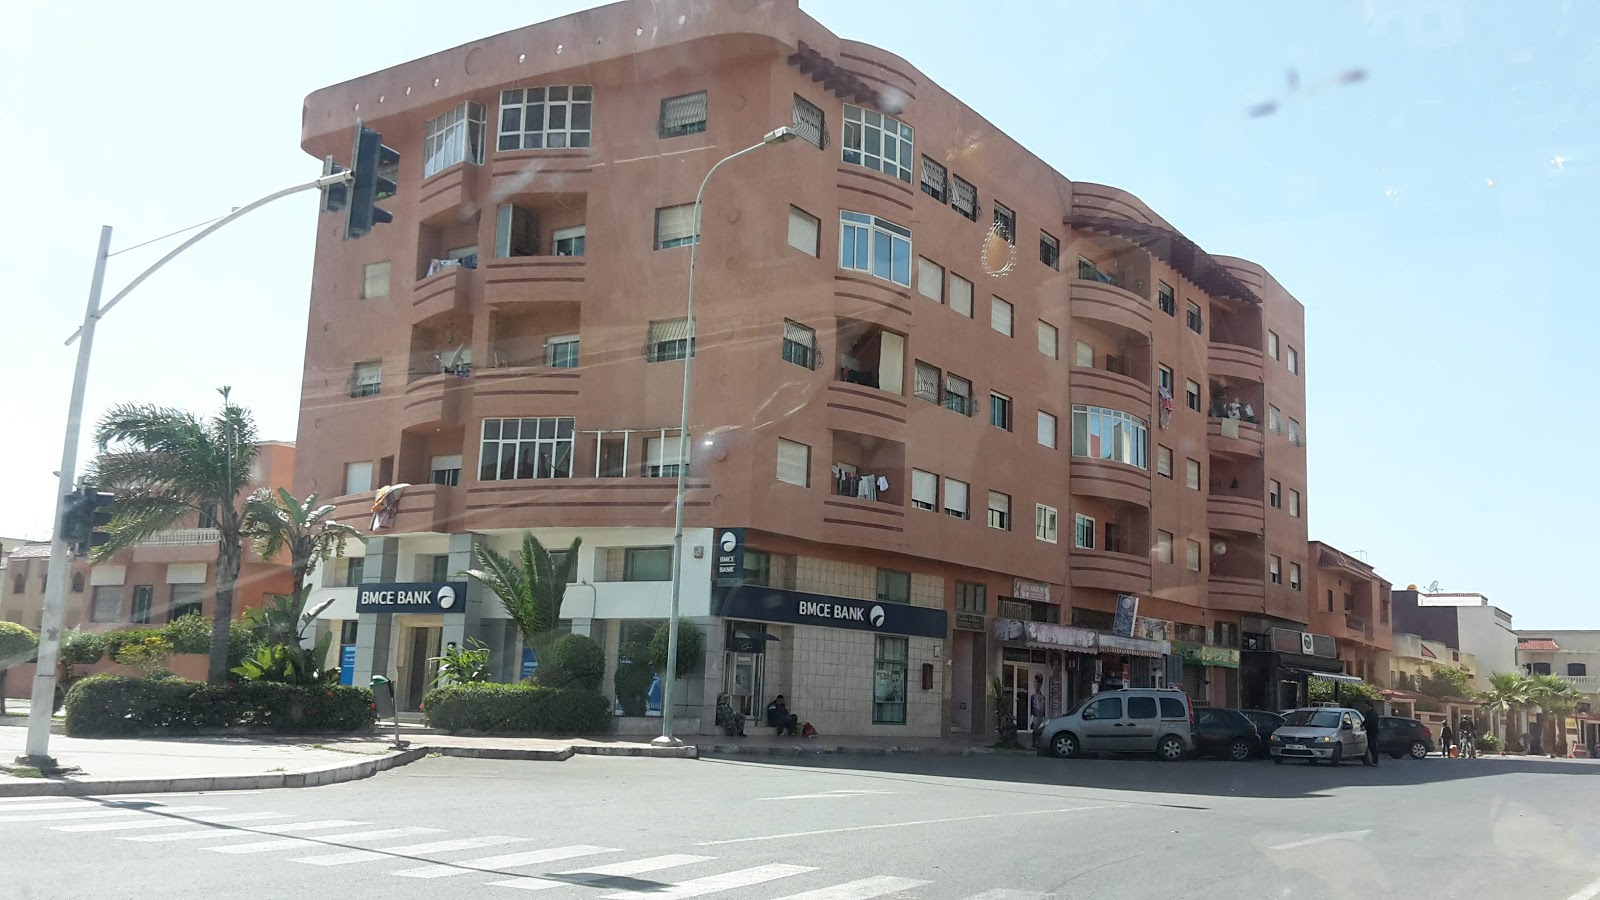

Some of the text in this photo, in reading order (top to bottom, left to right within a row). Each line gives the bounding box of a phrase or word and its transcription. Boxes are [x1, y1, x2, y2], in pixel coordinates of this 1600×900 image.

[719, 555, 736, 563] BMCE
[361, 590, 432, 605] BMCE BANK
[799, 601, 865, 621] BMCE BANK
